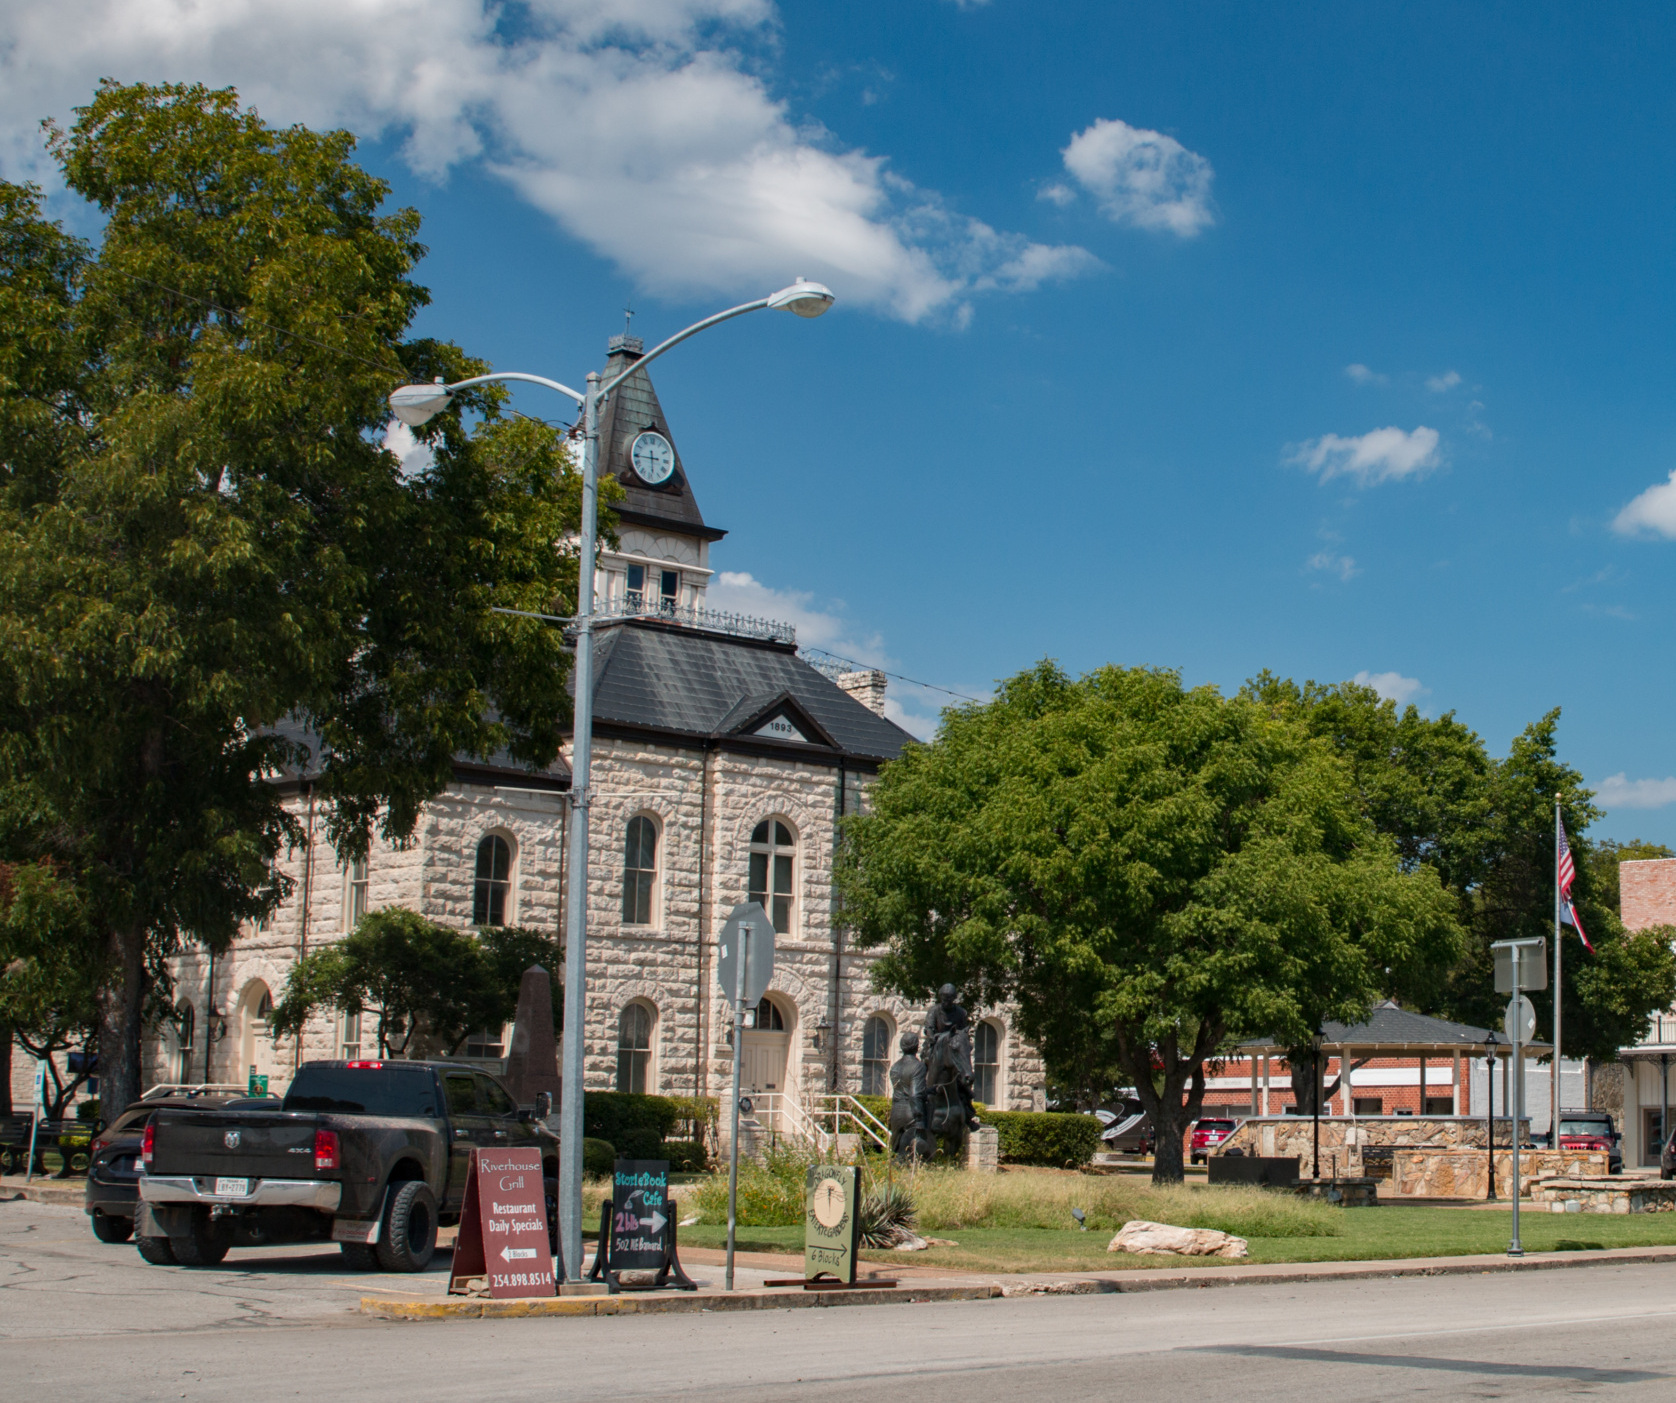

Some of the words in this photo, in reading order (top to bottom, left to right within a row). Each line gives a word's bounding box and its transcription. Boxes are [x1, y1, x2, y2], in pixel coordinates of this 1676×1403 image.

[770, 722, 792, 733] 1893
[481, 1158, 540, 1173] Riverhouse
[500, 1175, 524, 1191] Grill
[814, 1168, 847, 1187] DRAGONFLY
[643, 1190, 663, 1206] Cafe
[493, 1202, 537, 1214] Restaurant
[489, 1219, 510, 1235] Daily
[511, 1218, 543, 1234] Specials
[615, 1237, 629, 1251] 502
[512, 1250, 528, 1258] Blocks
[811, 1249, 817, 1261] 6
[818, 1250, 840, 1267] Blocks
[492, 1272, 551, 1287] 254.898.8514
